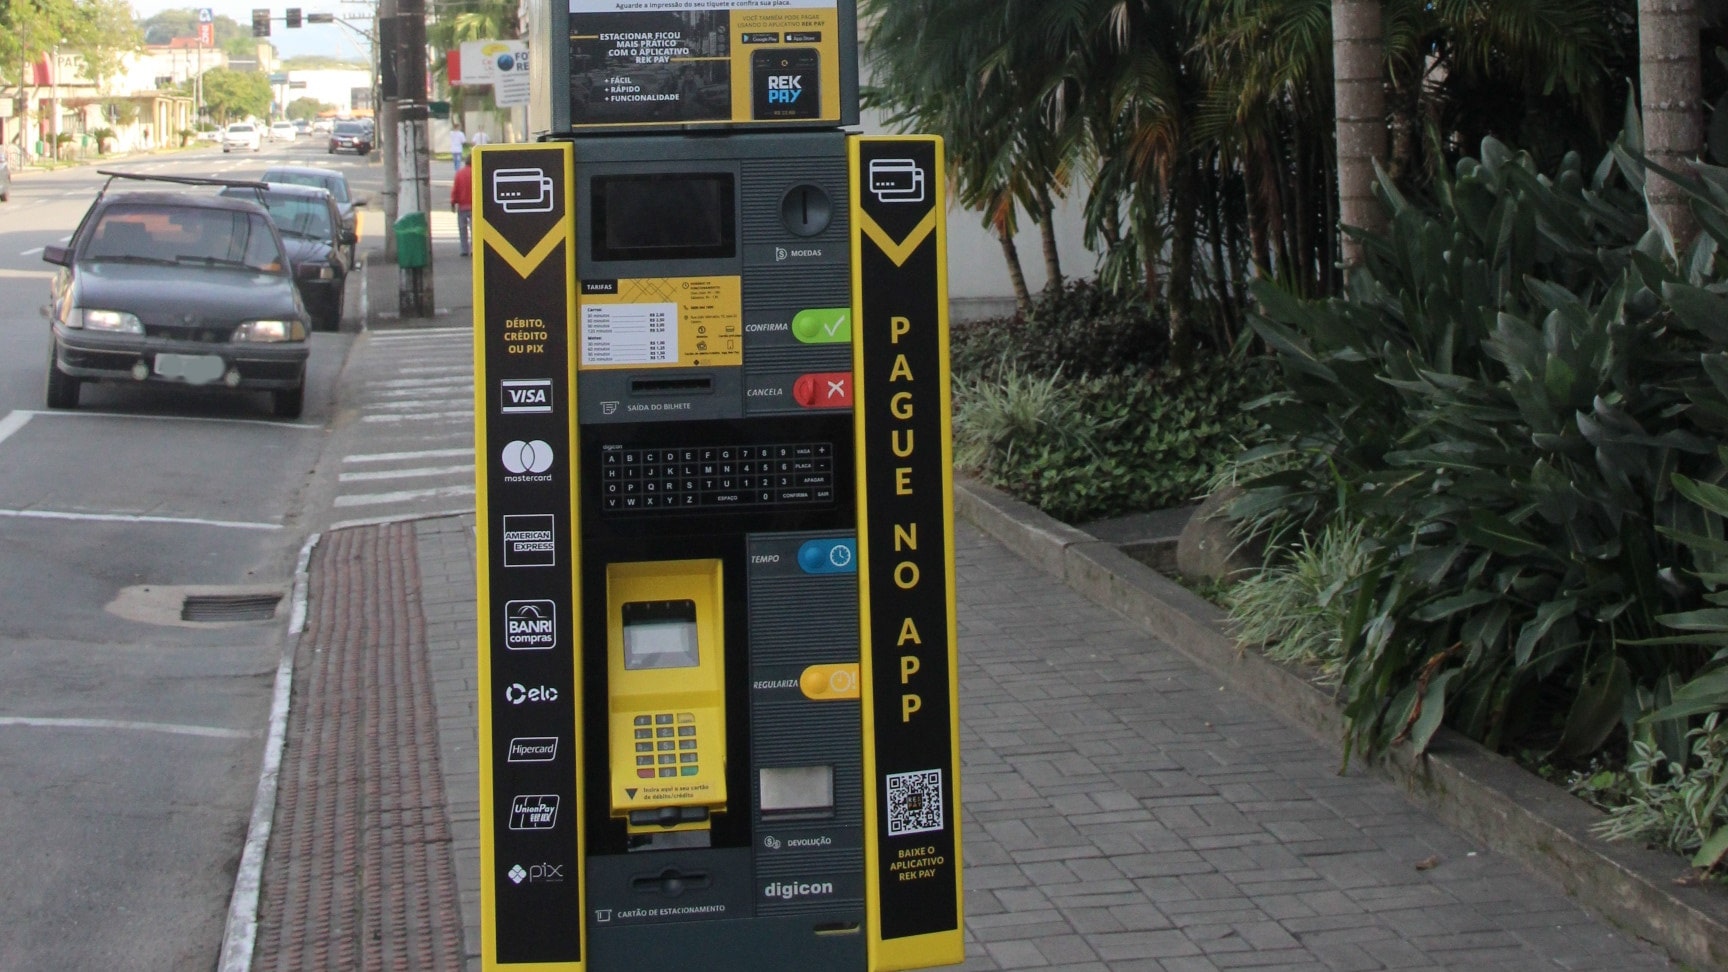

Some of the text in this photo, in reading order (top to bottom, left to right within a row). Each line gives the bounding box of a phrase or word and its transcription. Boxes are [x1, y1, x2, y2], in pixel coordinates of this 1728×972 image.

[600, 31, 681, 40] ESTACIONAR FICOU
[616, 38, 677, 48] MAIS PRÁTICO
[515, 51, 529, 61] FO
[630, 48, 637, 56] O
[639, 47, 689, 56] APLICATIVO
[636, 56, 652, 64] REK
[610, 75, 632, 84] FÁCIL
[768, 75, 802, 89] REK
[610, 85, 640, 93] RÁPIDO
[610, 93, 680, 102] FUNCIONALIDADE
[768, 89, 802, 104] PAY
[791, 249, 822, 257] MOEDAS
[505, 317, 545, 329] DÉBITO,
[745, 323, 788, 332] CONFIRMA
[504, 330, 548, 341] CRÉDITO
[508, 344, 544, 354] OU PIX
[508, 389, 546, 403] VISA
[747, 388, 783, 396] CANCELA
[627, 402, 649, 411] SAÍDA
[664, 402, 691, 410] BILHETE
[667, 467, 673, 475] K
[504, 474, 552, 482] mastercard
[609, 484, 616, 492] O
[706, 480, 712, 488] T
[763, 478, 768, 486] 2
[627, 498, 635, 506] W
[647, 497, 653, 505] X
[667, 496, 673, 504] Y
[889, 316, 922, 723] PAGUE NO APP
[505, 531, 550, 541] AMERICAN
[514, 542, 553, 551] EXPRESS
[751, 554, 780, 564] TEMPO
[509, 620, 552, 633] BANRI
[510, 635, 552, 645] compras
[753, 679, 799, 690] REGULARIZA
[512, 744, 554, 755] Hipercard
[515, 804, 555, 814] UnionPay
[787, 835, 832, 847] DEVOLUÇÃO
[898, 845, 935, 859] BAIXE O
[890, 856, 945, 871] APLICATIVO
[529, 862, 563, 883] pix
[899, 868, 936, 881] REK PAY
[765, 881, 833, 899] digicon
[617, 908, 647, 918] CARTÃO
[660, 904, 726, 916] ESTACIONAMENTO
